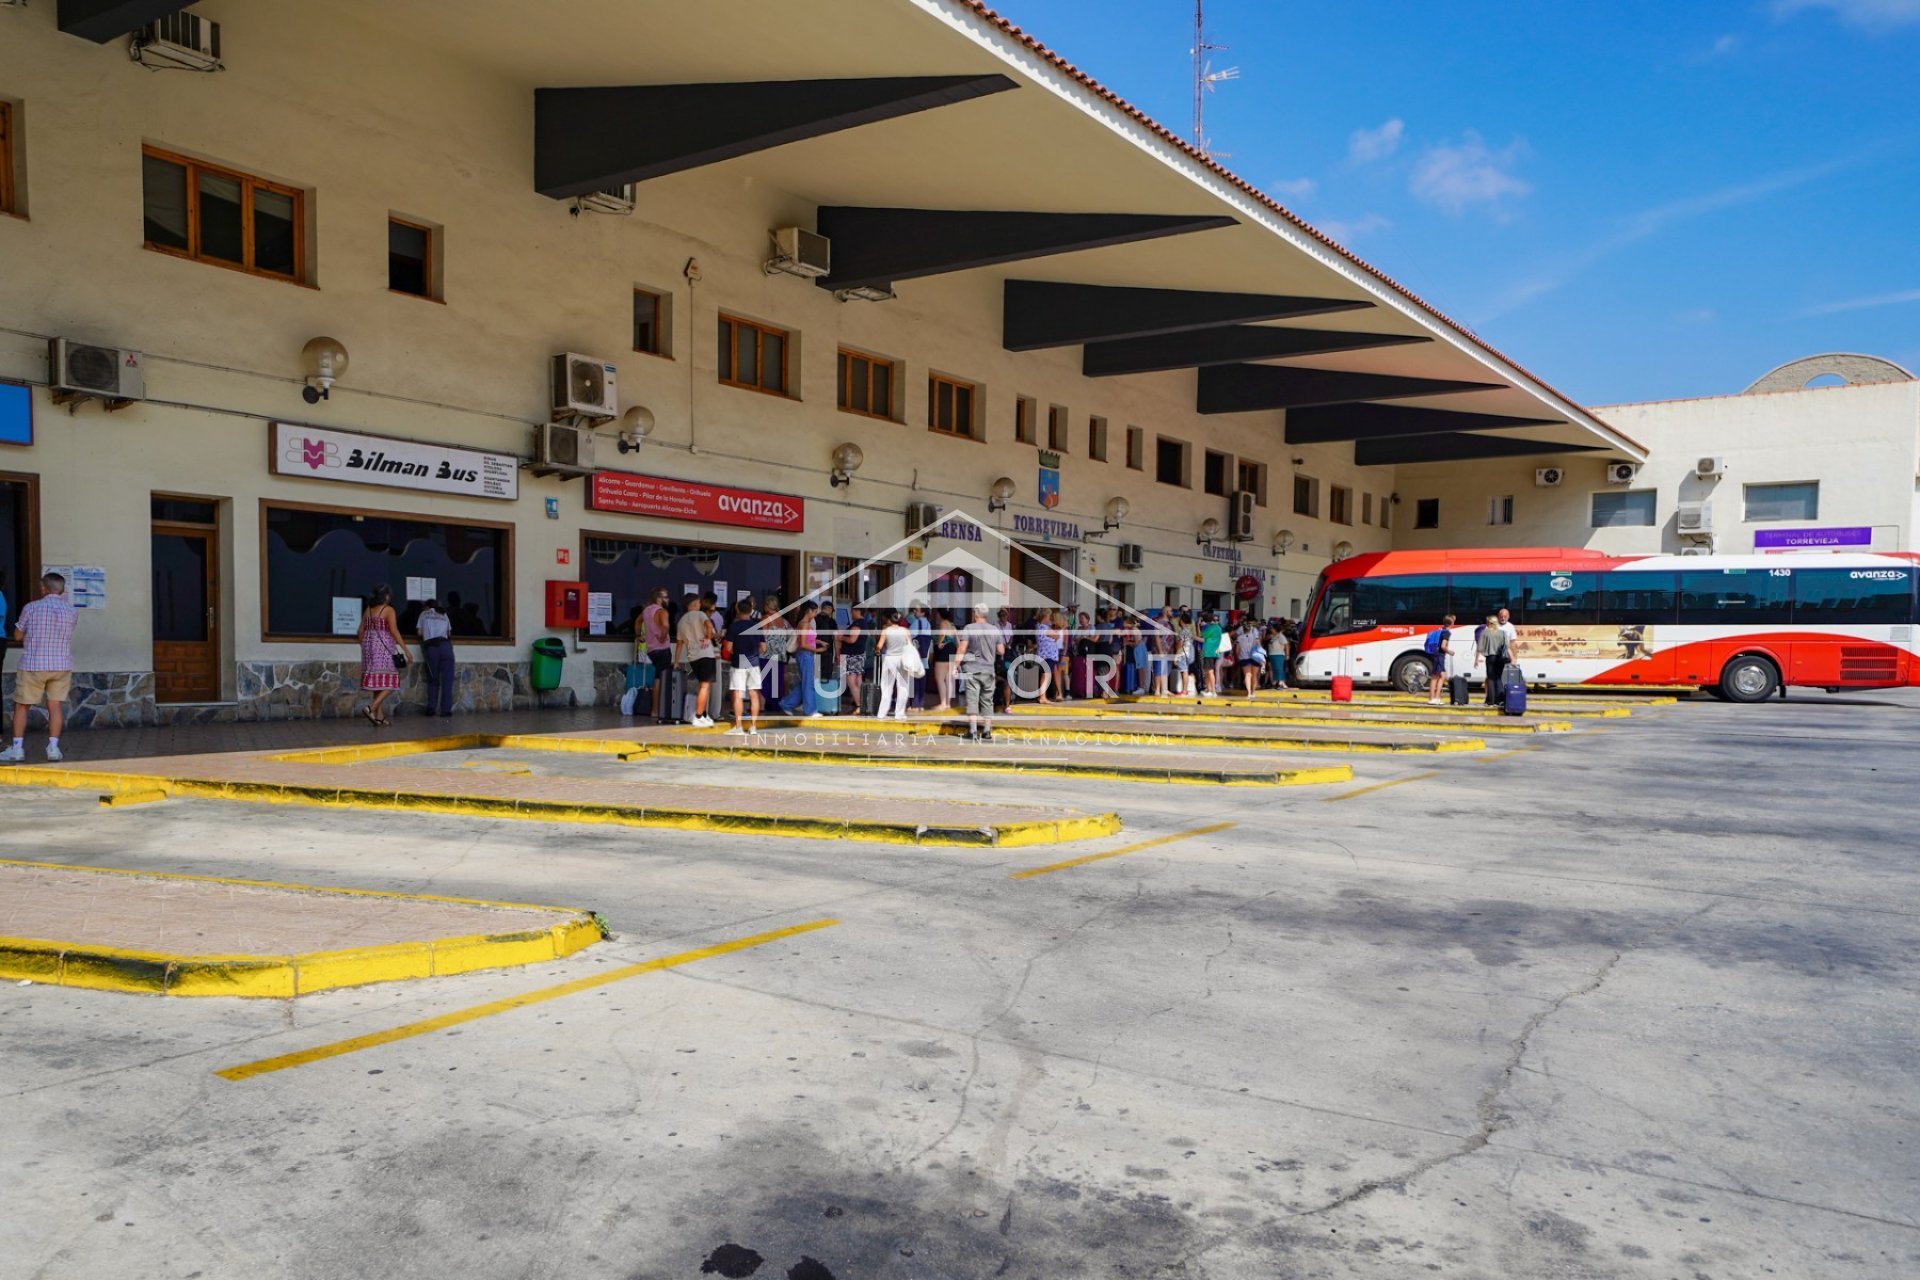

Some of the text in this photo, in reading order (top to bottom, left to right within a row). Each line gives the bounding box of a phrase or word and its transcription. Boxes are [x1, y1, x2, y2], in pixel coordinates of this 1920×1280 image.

[346, 448, 479, 483] Bilman Bus
[624, 480, 656, 490] Guardamar
[642, 492, 655, 500] Pilar
[718, 494, 783, 518] avanza
[938, 520, 983, 543] RENSA
[1013, 514, 1080, 539] TORREVIEJA
[1785, 537, 1839, 545] TORREVIEJA
[1768, 569, 1791, 577] 1430
[1850, 570, 1896, 579] avanza
